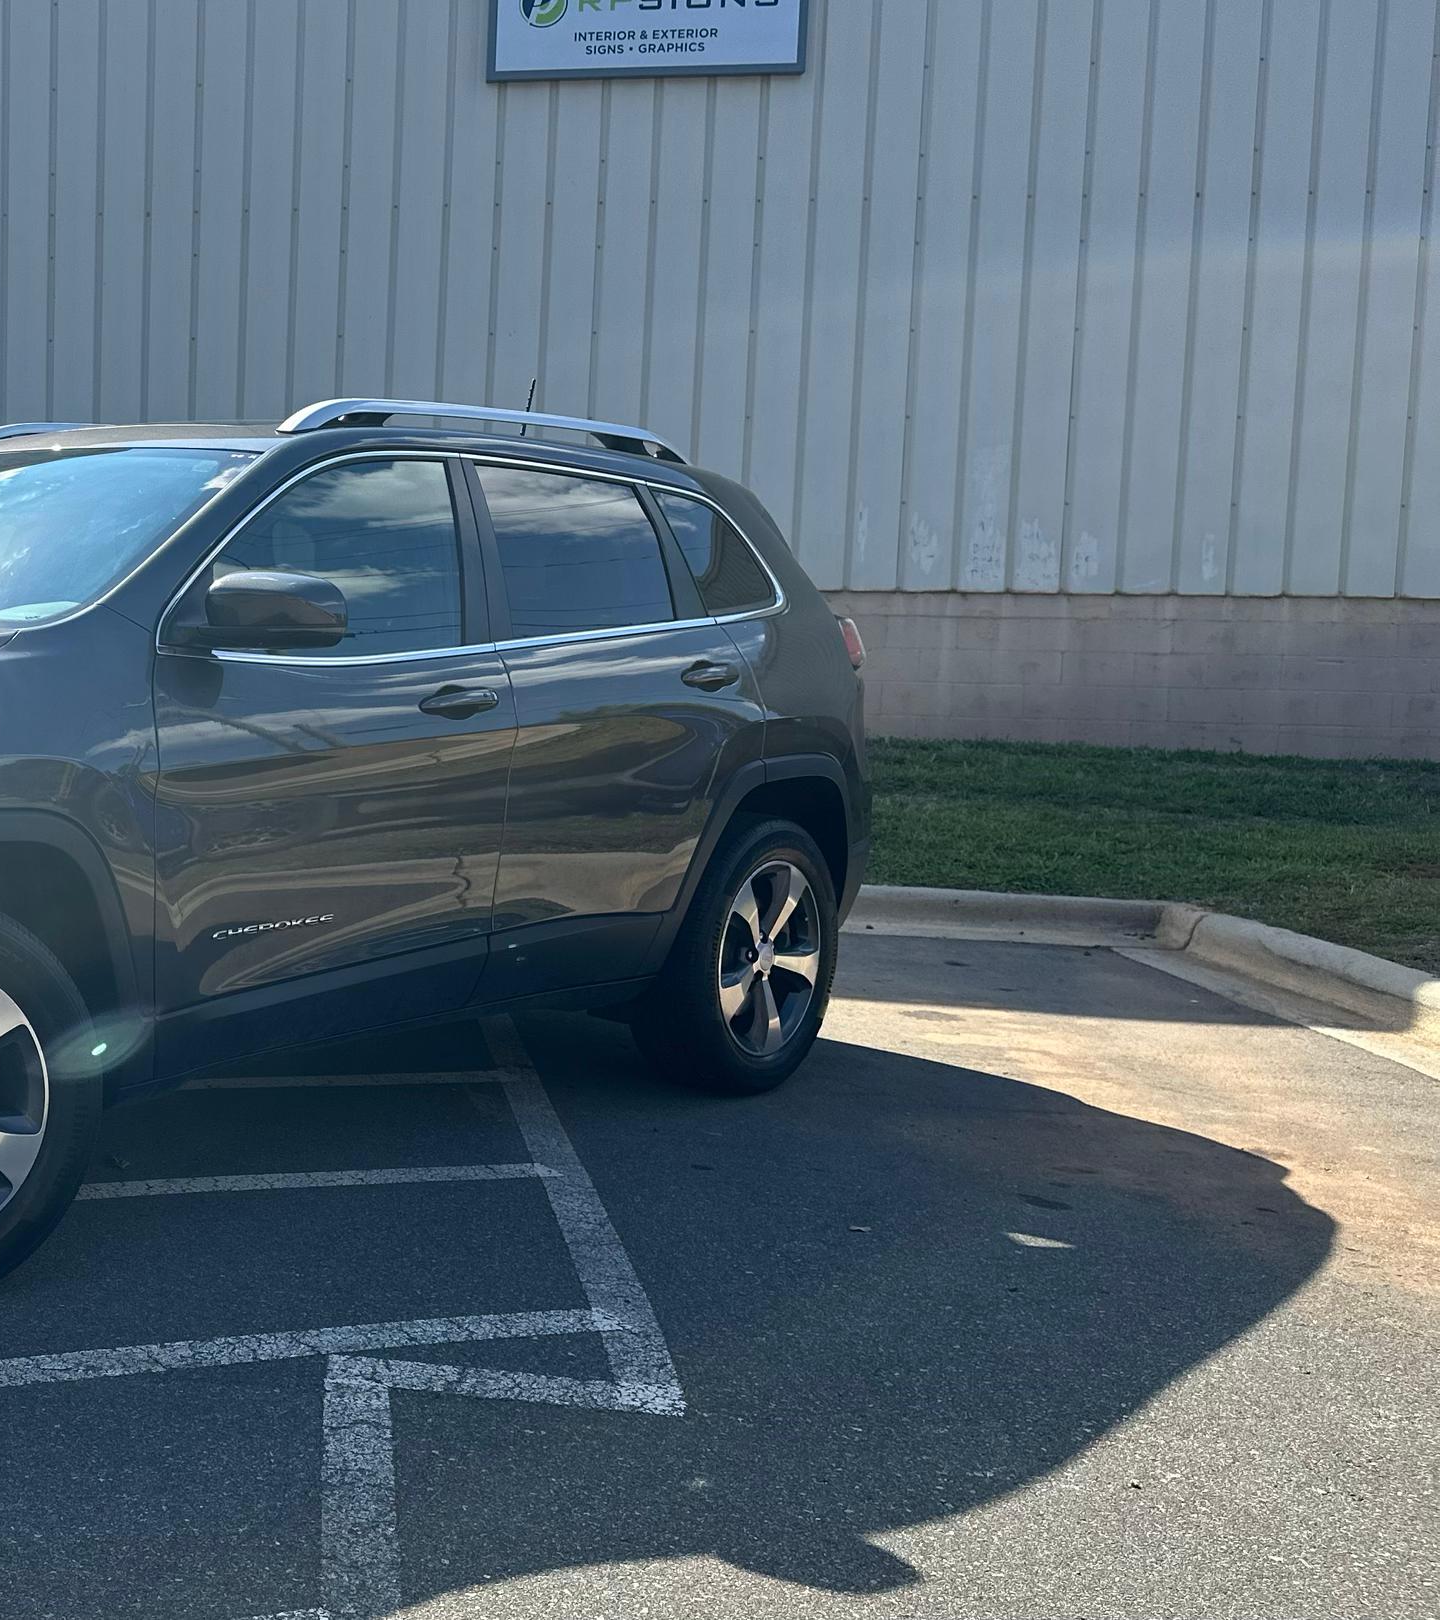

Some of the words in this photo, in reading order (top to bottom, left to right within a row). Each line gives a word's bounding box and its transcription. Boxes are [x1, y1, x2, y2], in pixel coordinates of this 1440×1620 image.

[574, 30, 636, 42] INTERIOR
[640, 30, 648, 40] &
[653, 28, 719, 40] EXTERIOR
[585, 44, 624, 55] SIGNS
[638, 42, 705, 54] GRAPHICS
[212, 913, 335, 940] CHEROKEE
